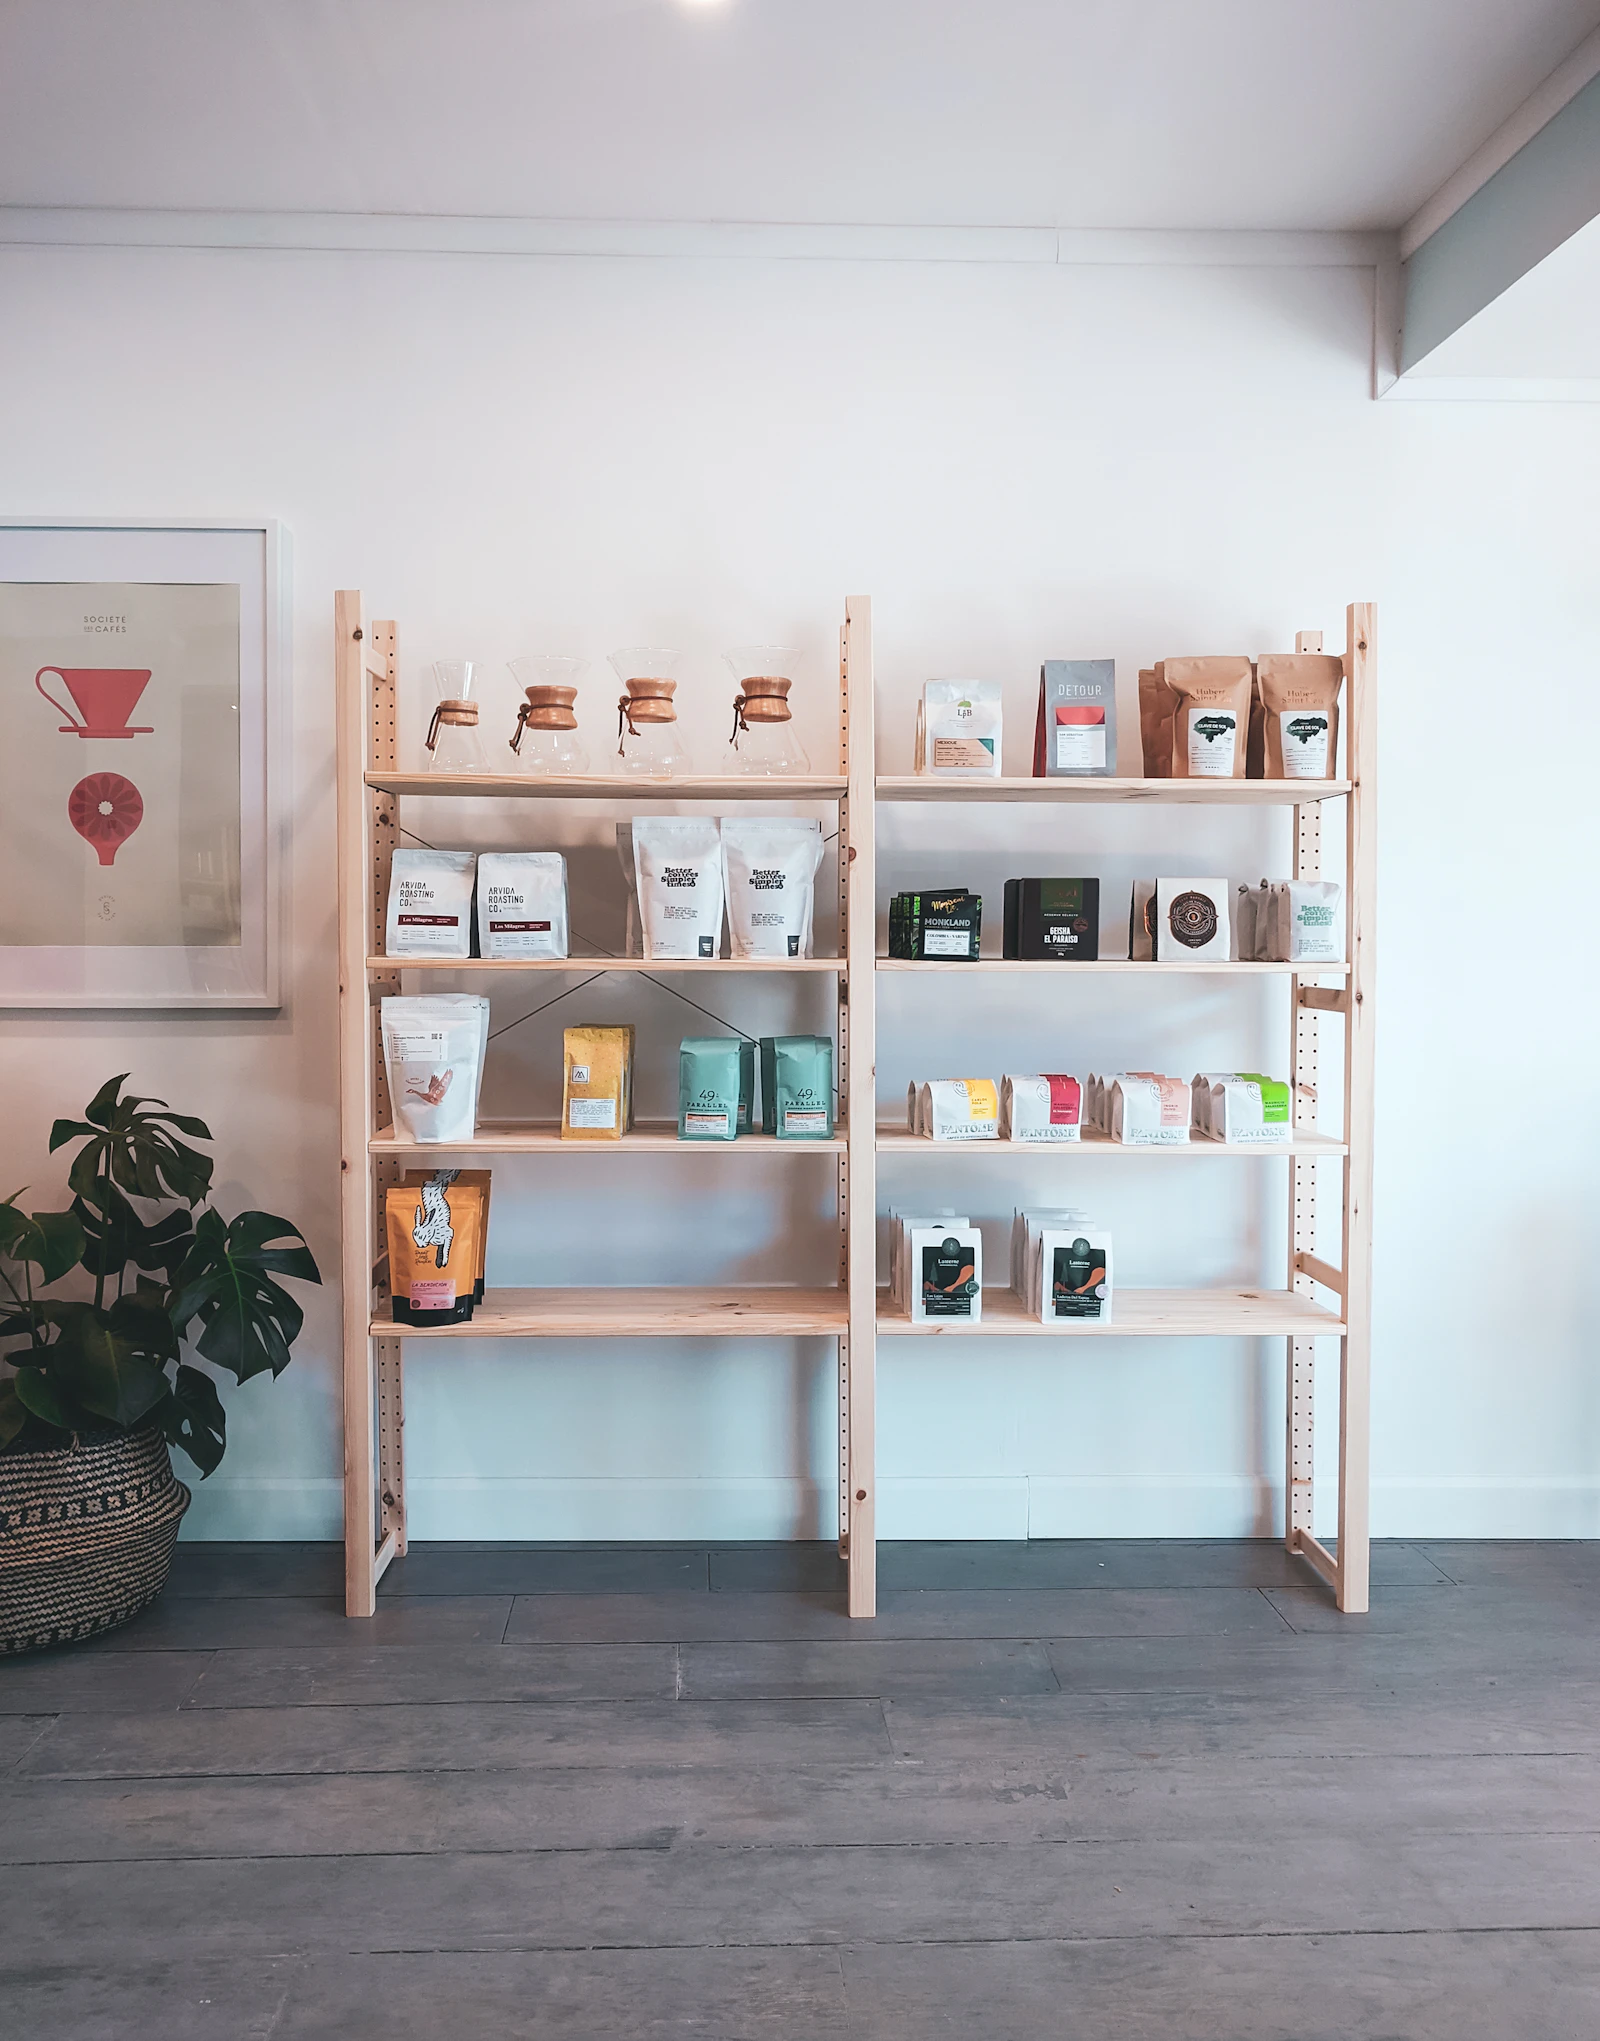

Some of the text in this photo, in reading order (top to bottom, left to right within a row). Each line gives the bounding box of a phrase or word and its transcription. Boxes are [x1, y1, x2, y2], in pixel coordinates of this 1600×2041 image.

[1058, 684, 1102, 696] DETOUR
[661, 876, 697, 884] Simpler
[400, 881, 427, 890] ARVIDA
[399, 889, 435, 899] ROASTING
[488, 886, 515, 895] ARVIDA
[399, 898, 413, 907] CO.
[488, 895, 524, 904] ROASTING
[488, 904, 502, 913] CO.
[925, 918, 971, 927] MONKLAND
[1049, 926, 1071, 935] GEISHA
[1044, 935, 1079, 944] EL PARAISO
